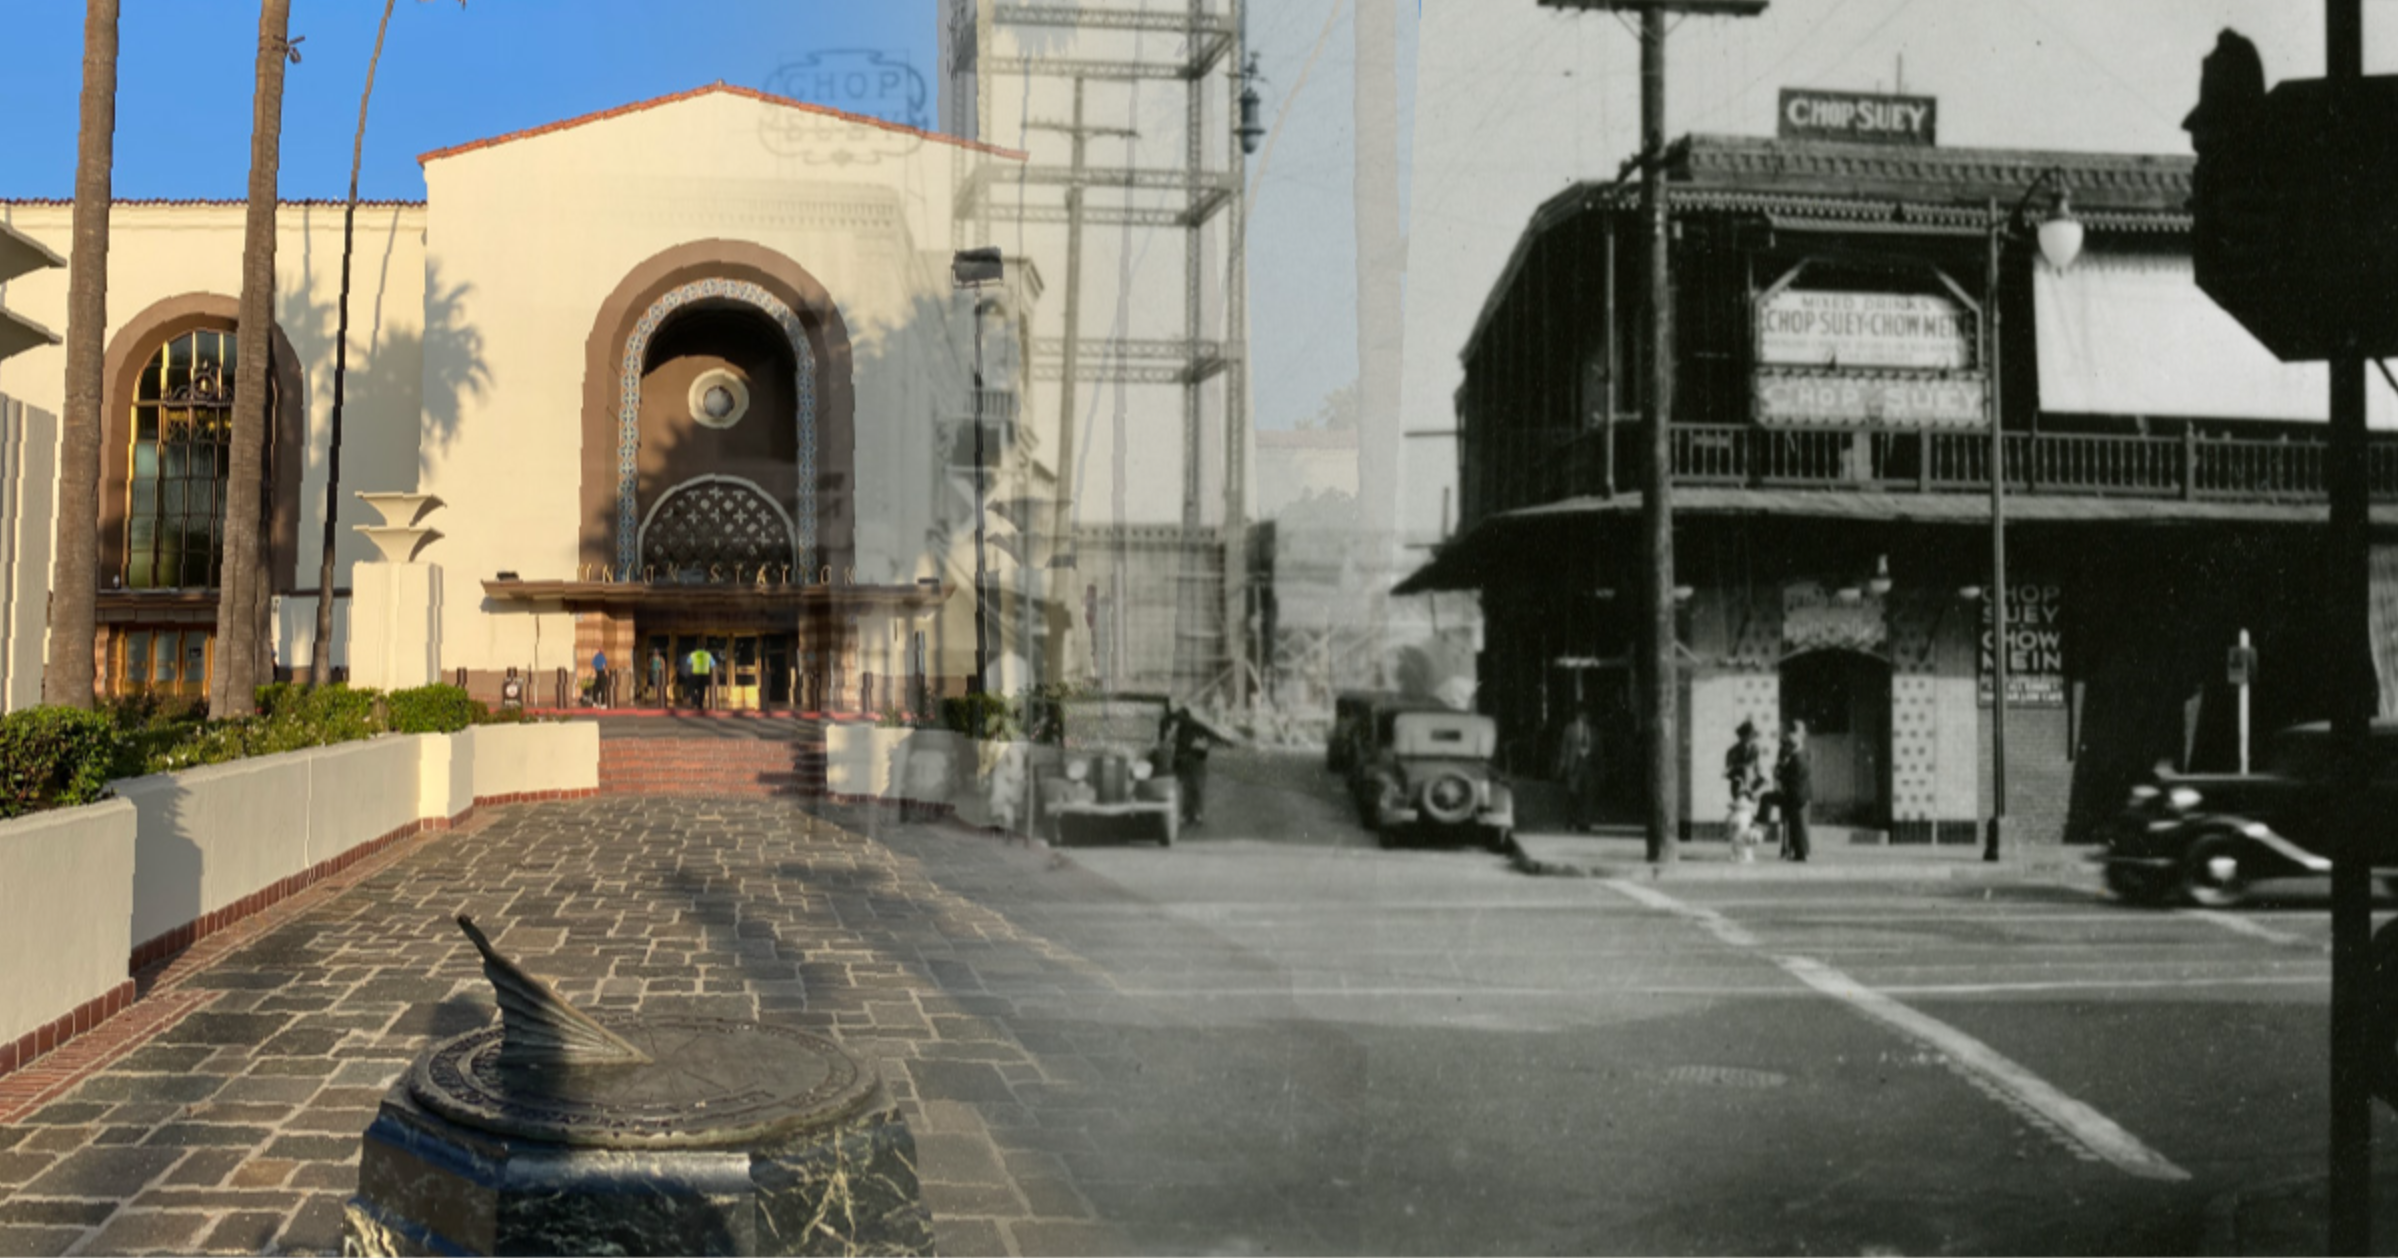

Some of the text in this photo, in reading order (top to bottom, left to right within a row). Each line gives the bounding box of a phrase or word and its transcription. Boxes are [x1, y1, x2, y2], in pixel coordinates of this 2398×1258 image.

[785, 71, 900, 99] CHOP
[1788, 99, 1927, 132] CHOP SUEY
[1802, 296, 1931, 311] MIXED DRINKS
[1766, 310, 1815, 333] CHOP
[1763, 386, 1981, 410] CHOP SUEY
[577, 562, 857, 586] UNION STATION
[1982, 585, 2060, 604] CHOP
[1982, 630, 2061, 650] CHOW
